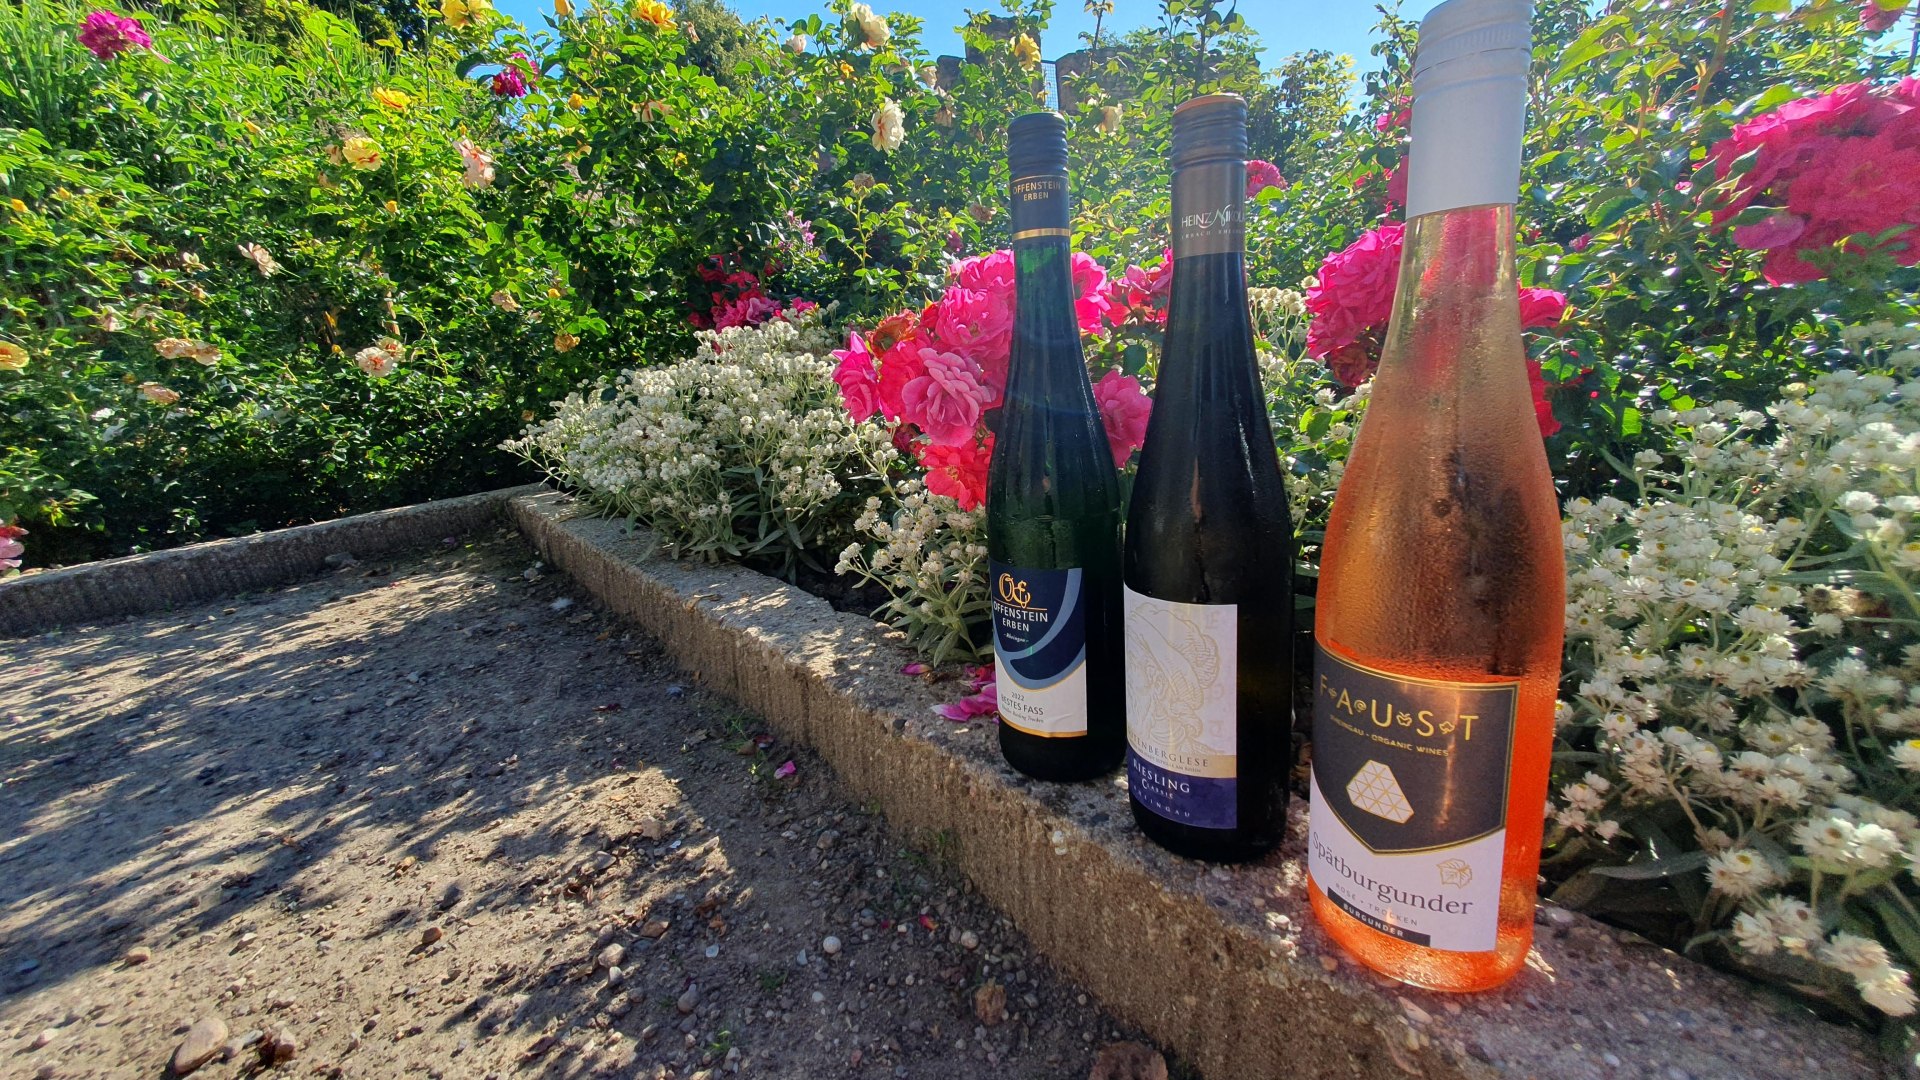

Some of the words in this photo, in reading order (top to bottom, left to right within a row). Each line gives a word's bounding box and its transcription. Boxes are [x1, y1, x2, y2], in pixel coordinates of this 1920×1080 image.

[1012, 181, 1061, 195] OFFENSTEIN
[1023, 191, 1049, 201] ERBEN
[1181, 211, 1212, 228] HEINZ
[993, 601, 1048, 622] OFFENSTEIN
[1002, 617, 1030, 632] ERBEN
[1011, 692, 1025, 702] 2022
[1023, 704, 1044, 716] FASS
[1371, 734, 1414, 751] ORGANIC
[1416, 745, 1450, 757] WINES
[1133, 758, 1190, 793] RIESLING
[1311, 831, 1474, 915] Spätburgunder
[1343, 902, 1404, 938] BURGUNDER
